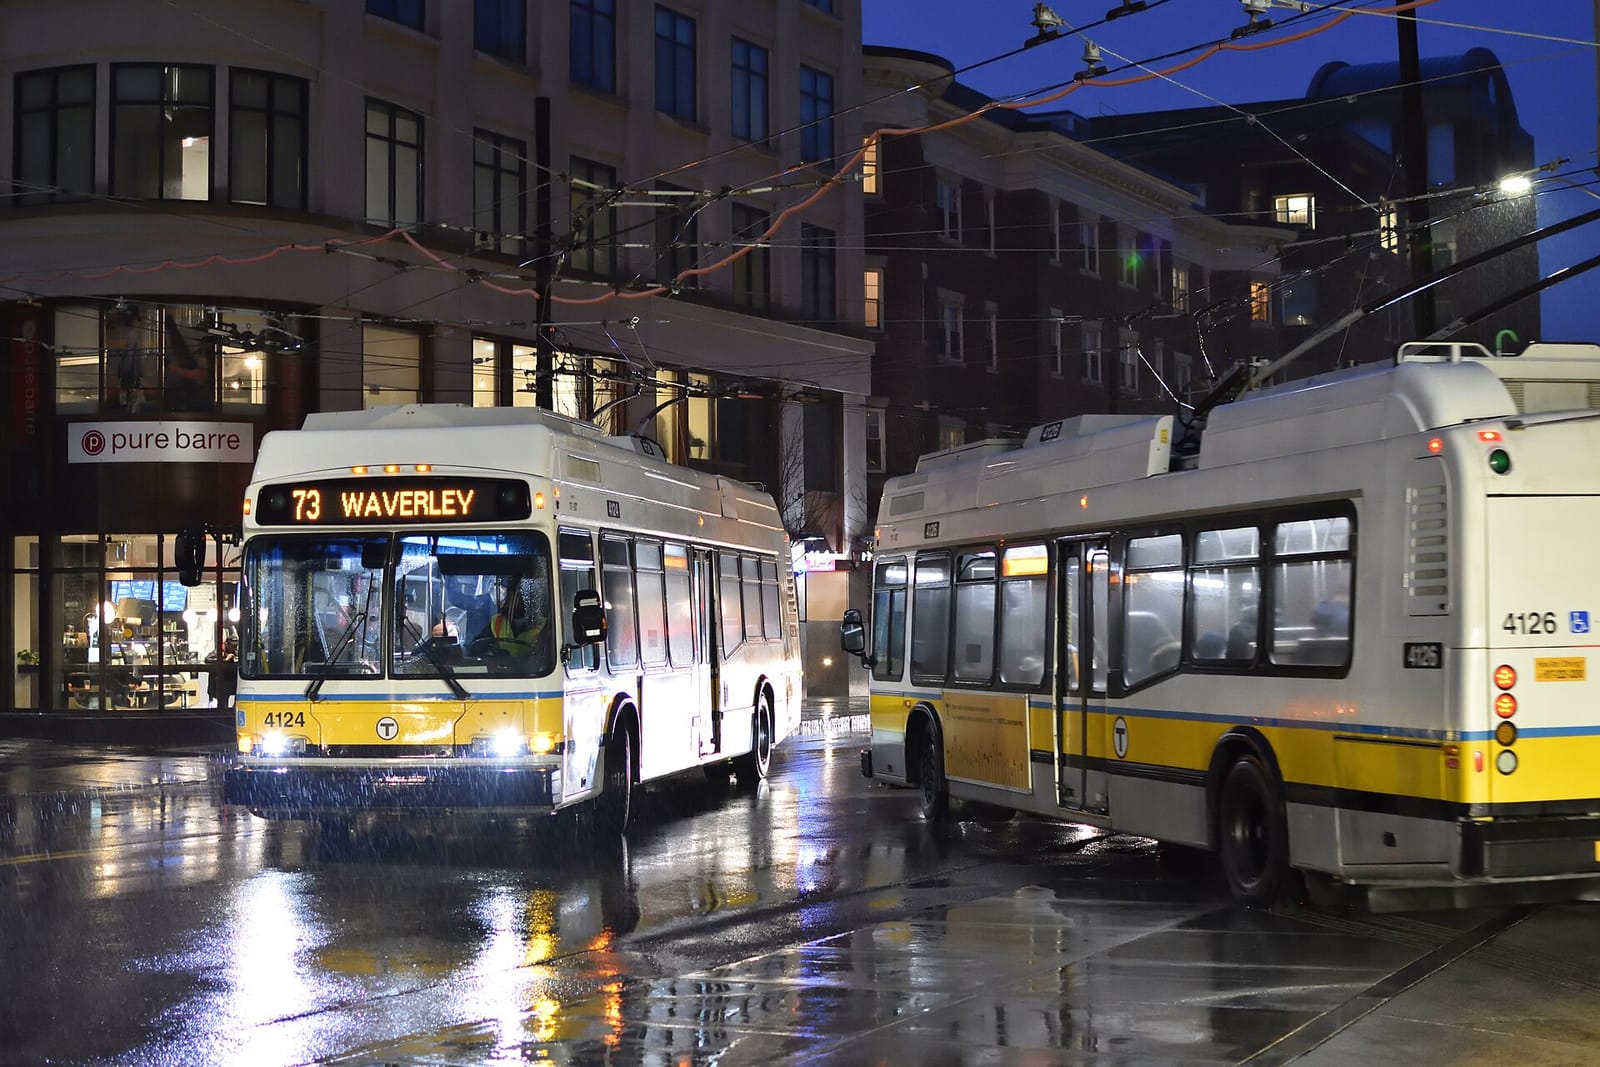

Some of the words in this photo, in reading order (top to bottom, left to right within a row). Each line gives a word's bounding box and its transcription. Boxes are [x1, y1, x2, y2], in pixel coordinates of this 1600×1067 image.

[111, 431, 169, 454] pure
[175, 428, 241, 450] barre
[292, 489, 322, 521] 73
[341, 489, 474, 517] WAVERLEY
[1502, 611, 1557, 635] 4126
[1407, 645, 1439, 667] 4126
[264, 711, 305, 728] 4124
[380, 723, 395, 737] T
[1115, 727, 1126, 752] T
